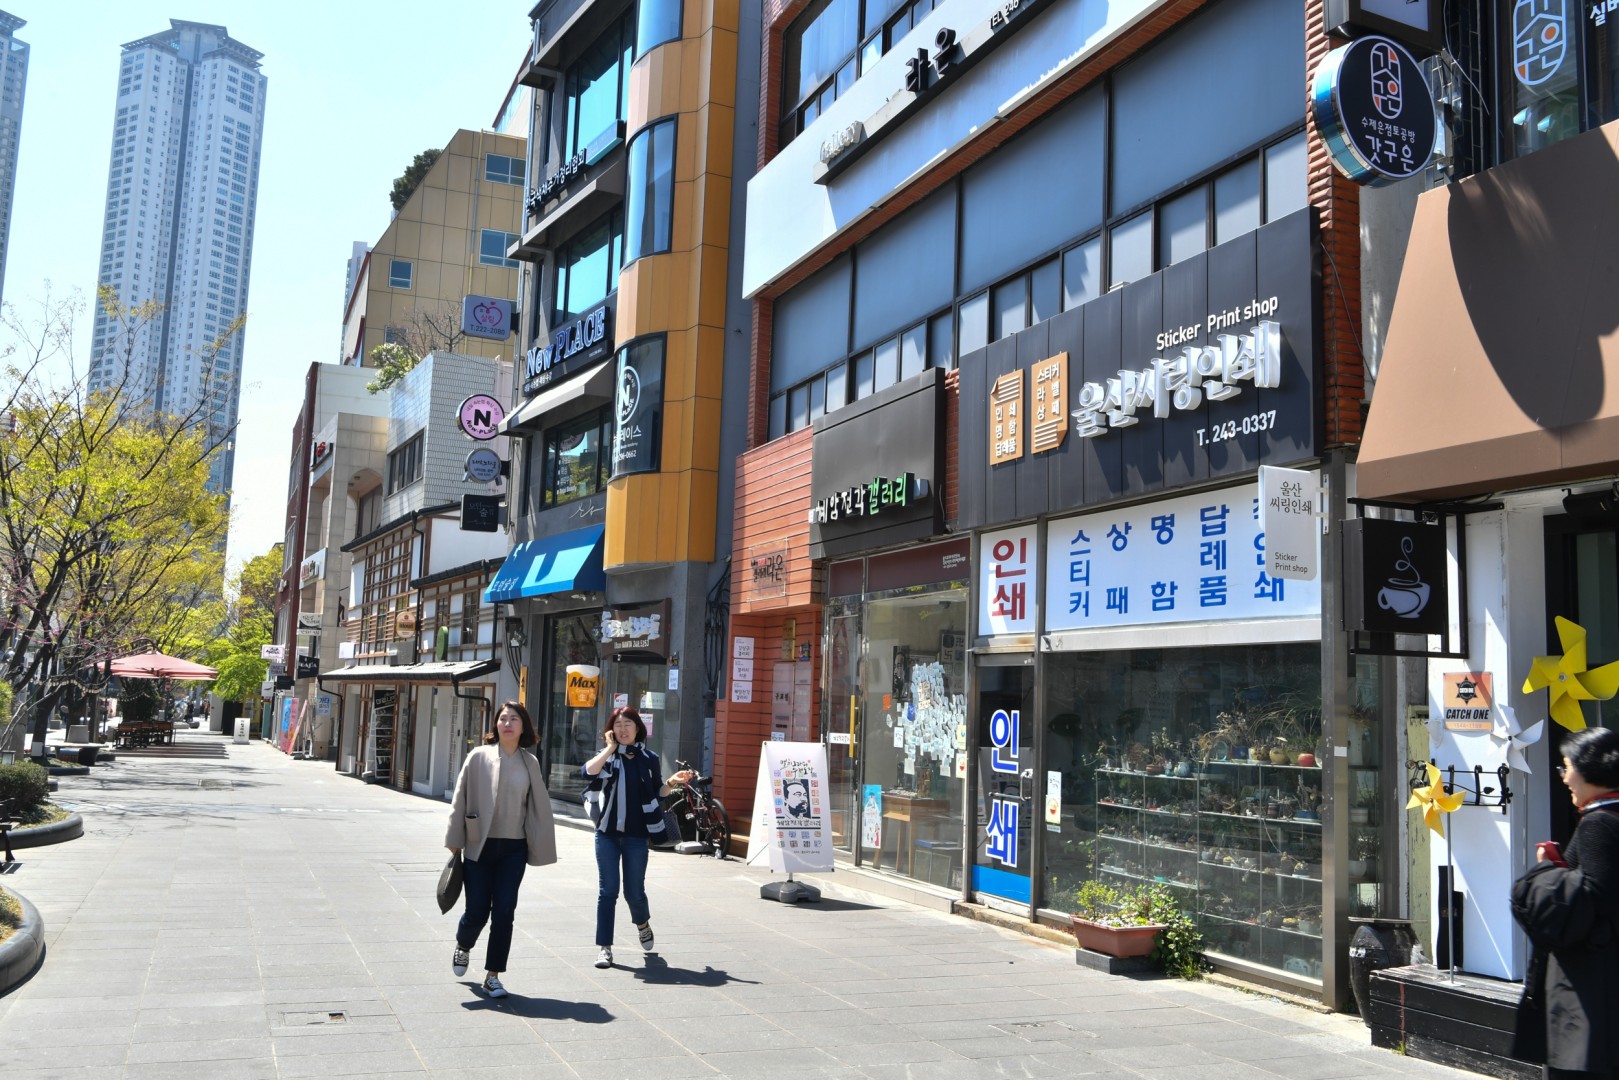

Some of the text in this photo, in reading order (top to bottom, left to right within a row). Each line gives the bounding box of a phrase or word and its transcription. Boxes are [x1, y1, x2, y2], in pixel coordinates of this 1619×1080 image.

[820, 120, 863, 163] Gallery
[905, 27, 957, 92] 라온
[1361, 116, 1415, 144] 수제은점토공방
[1365, 135, 1414, 172] 갓구은
[1156, 296, 1278, 351] Sticker Print shop
[526, 306, 606, 379] New PLACE
[1037, 362, 1060, 384] 스티커
[1071, 320, 1281, 438] 울산씨링인쇄
[473, 408, 491, 428] N
[1212, 410, 1277, 443] 243-0337
[1270, 496, 1312, 516] 씨링인쇄
[1280, 481, 1302, 497] 울산
[1069, 529, 1091, 617] 스티커
[1106, 521, 1132, 615] 상패
[1151, 513, 1178, 612] 명함
[1200, 504, 1230, 608] 답례품
[1274, 552, 1298, 561] Sticker
[1275, 562, 1308, 574] Print shop
[992, 537, 1027, 622] 인쇄
[570, 676, 596, 689] Max
[1446, 708, 1490, 720] CATCH ONE
[985, 708, 1020, 868] 인쇄
